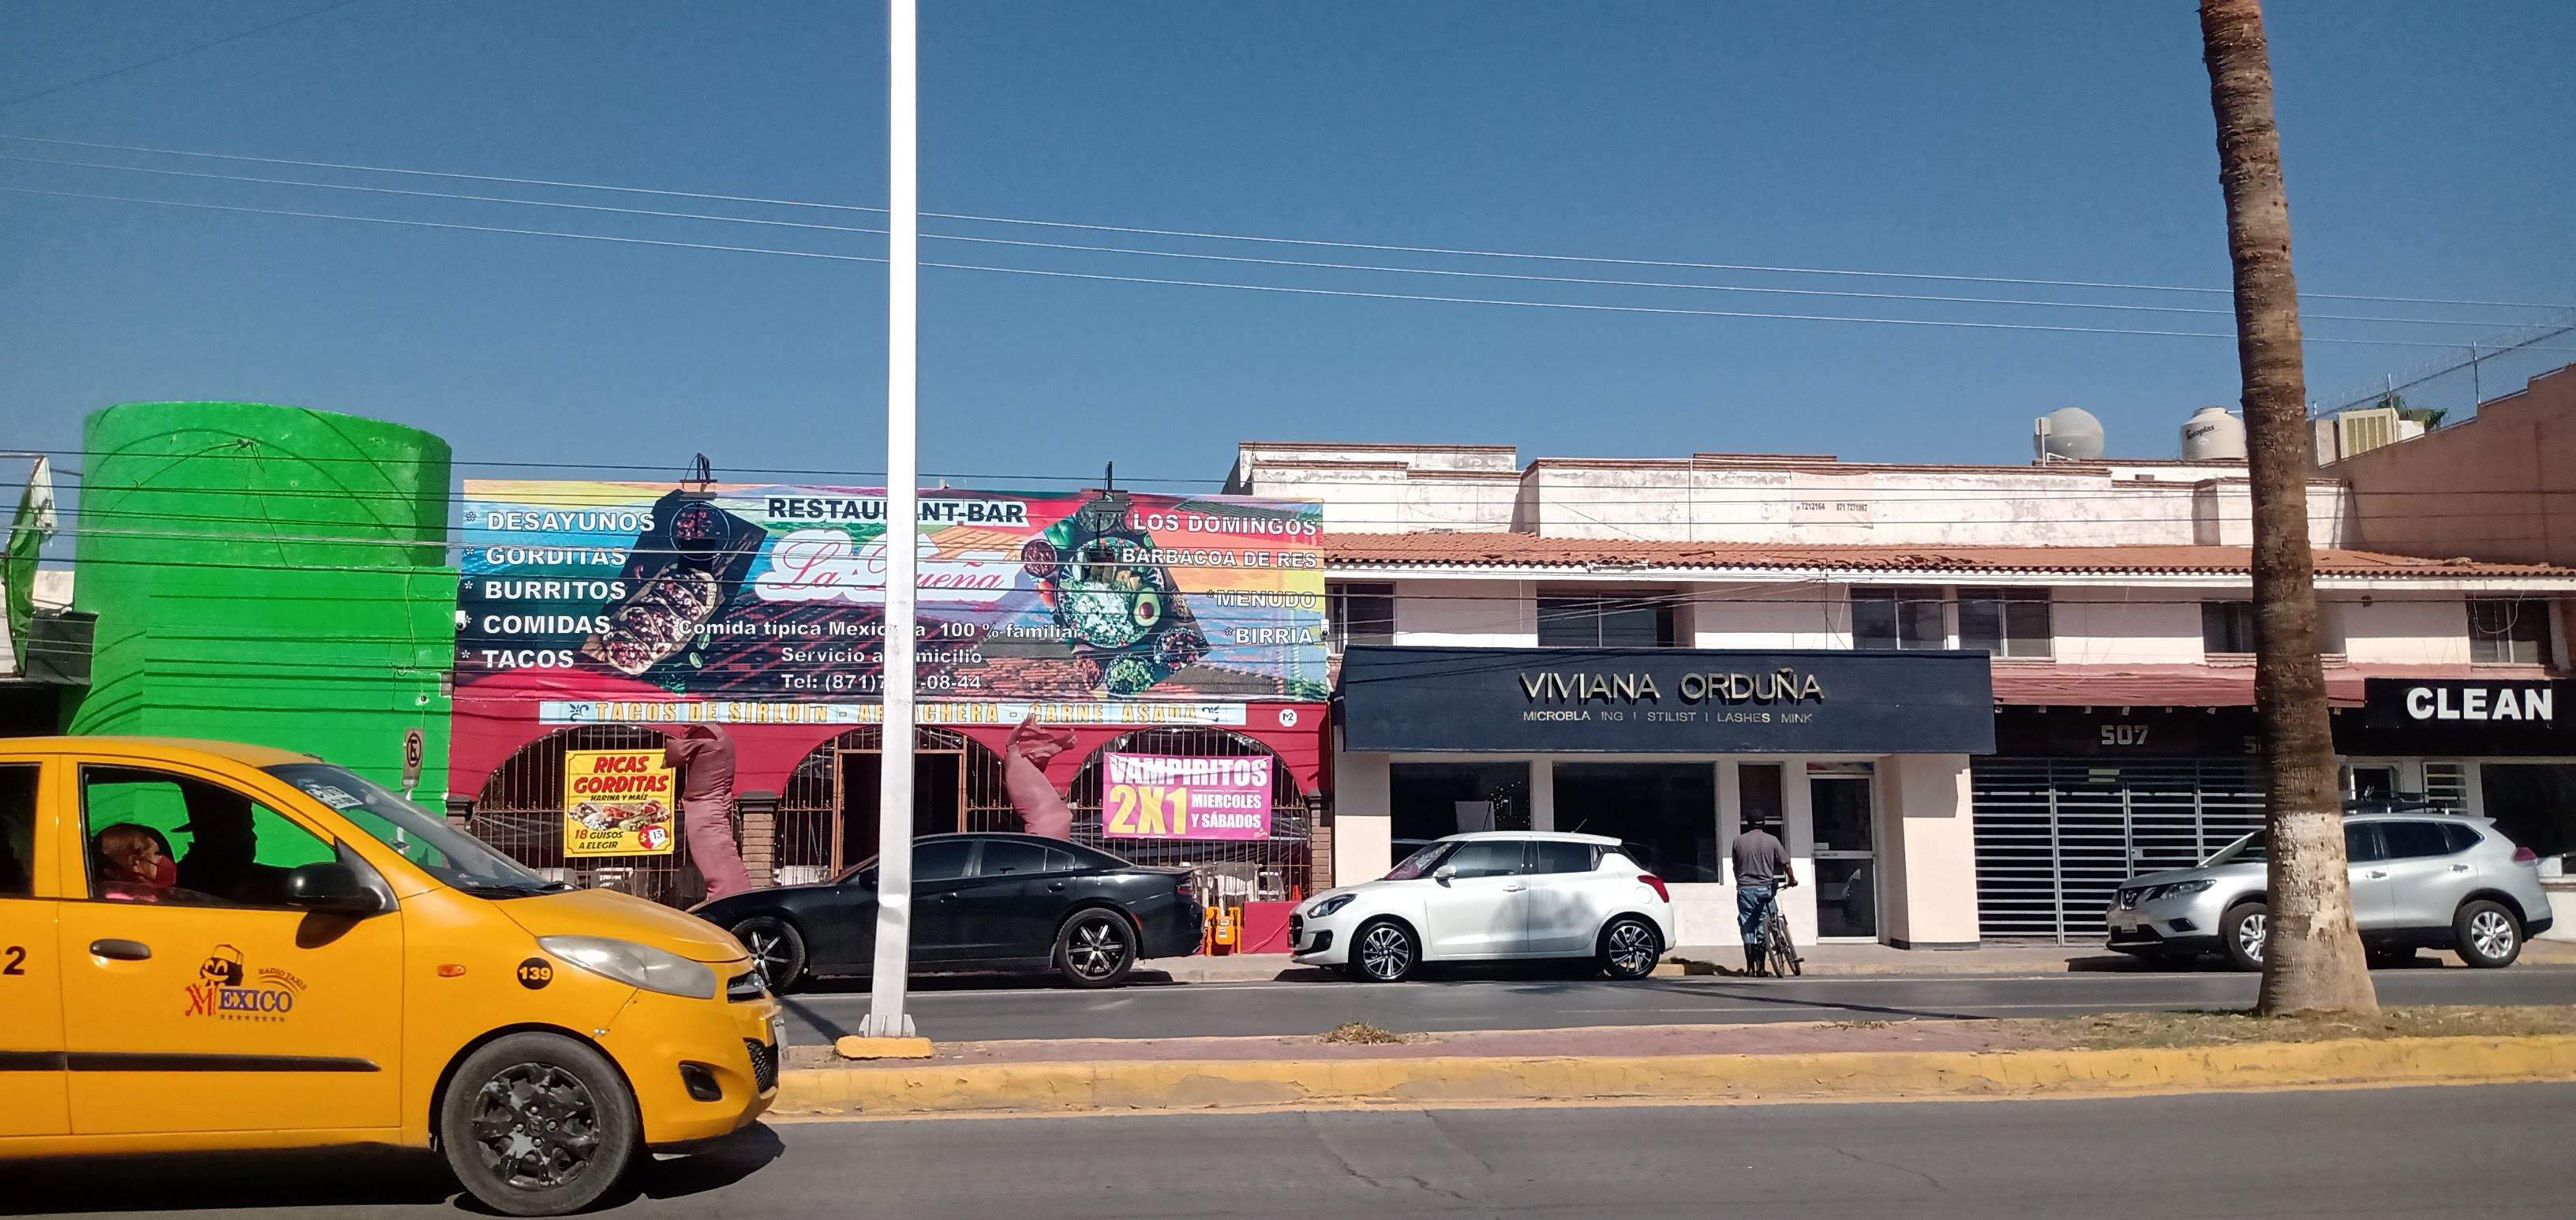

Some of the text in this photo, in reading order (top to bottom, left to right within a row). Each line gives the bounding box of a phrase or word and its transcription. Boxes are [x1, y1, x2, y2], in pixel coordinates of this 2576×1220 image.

[768, 499, 1024, 523] RESTAUNT-BAR
[487, 511, 655, 532] DESAYUNOS
[1133, 513, 1317, 536] LOS DOMINGOS
[485, 546, 627, 566] GORDITAS
[767, 541, 841, 590] La
[1122, 548, 1318, 568] BARBACOA DE RES
[485, 581, 627, 600] BURRITOS
[483, 615, 611, 634] COMIDAS
[679, 620, 756, 635] Comida
[764, 621, 822, 638] típica
[829, 621, 925, 637] Mexica
[940, 623, 975, 638] 100
[1006, 623, 1080, 638] familiar
[1235, 627, 1314, 645] BIRRIA
[481, 649, 575, 668] TACOS
[781, 647, 983, 664] Servicio a micilio
[781, 674, 818, 689] Tel:
[1520, 667, 1824, 700] VIVIANA ORDUÑA
[596, 702, 677, 723] TACOS
[688, 702, 717, 722] DE
[728, 702, 828, 722] SIRLOIN
[858, 702, 999, 723] ARCHERA
[1028, 703, 1104, 724] CARNE
[1122, 703, 1198, 724] ASADA
[2406, 687, 2552, 720] CLEAN
[1647, 712, 1696, 722] STILIST
[1717, 713, 1770, 723] LASHES
[1781, 713, 1813, 724] MINK
[2100, 724, 2148, 745] 507
[593, 756, 650, 773] RICAS
[1109, 754, 1268, 787] VAMPIRITOS
[574, 775, 669, 794] GORDITAS
[628, 792, 649, 801] MAÍZ
[1191, 794, 1262, 809] MIERCOLES
[1108, 784, 1187, 835] 2X1
[1191, 811, 1262, 829] Y SÁBADOS
[575, 829, 623, 840] 18 GUISOS
[258, 967, 308, 991] RADIO TAXIS
[519, 967, 551, 980] 139
[185, 983, 293, 1017] MEXICO
